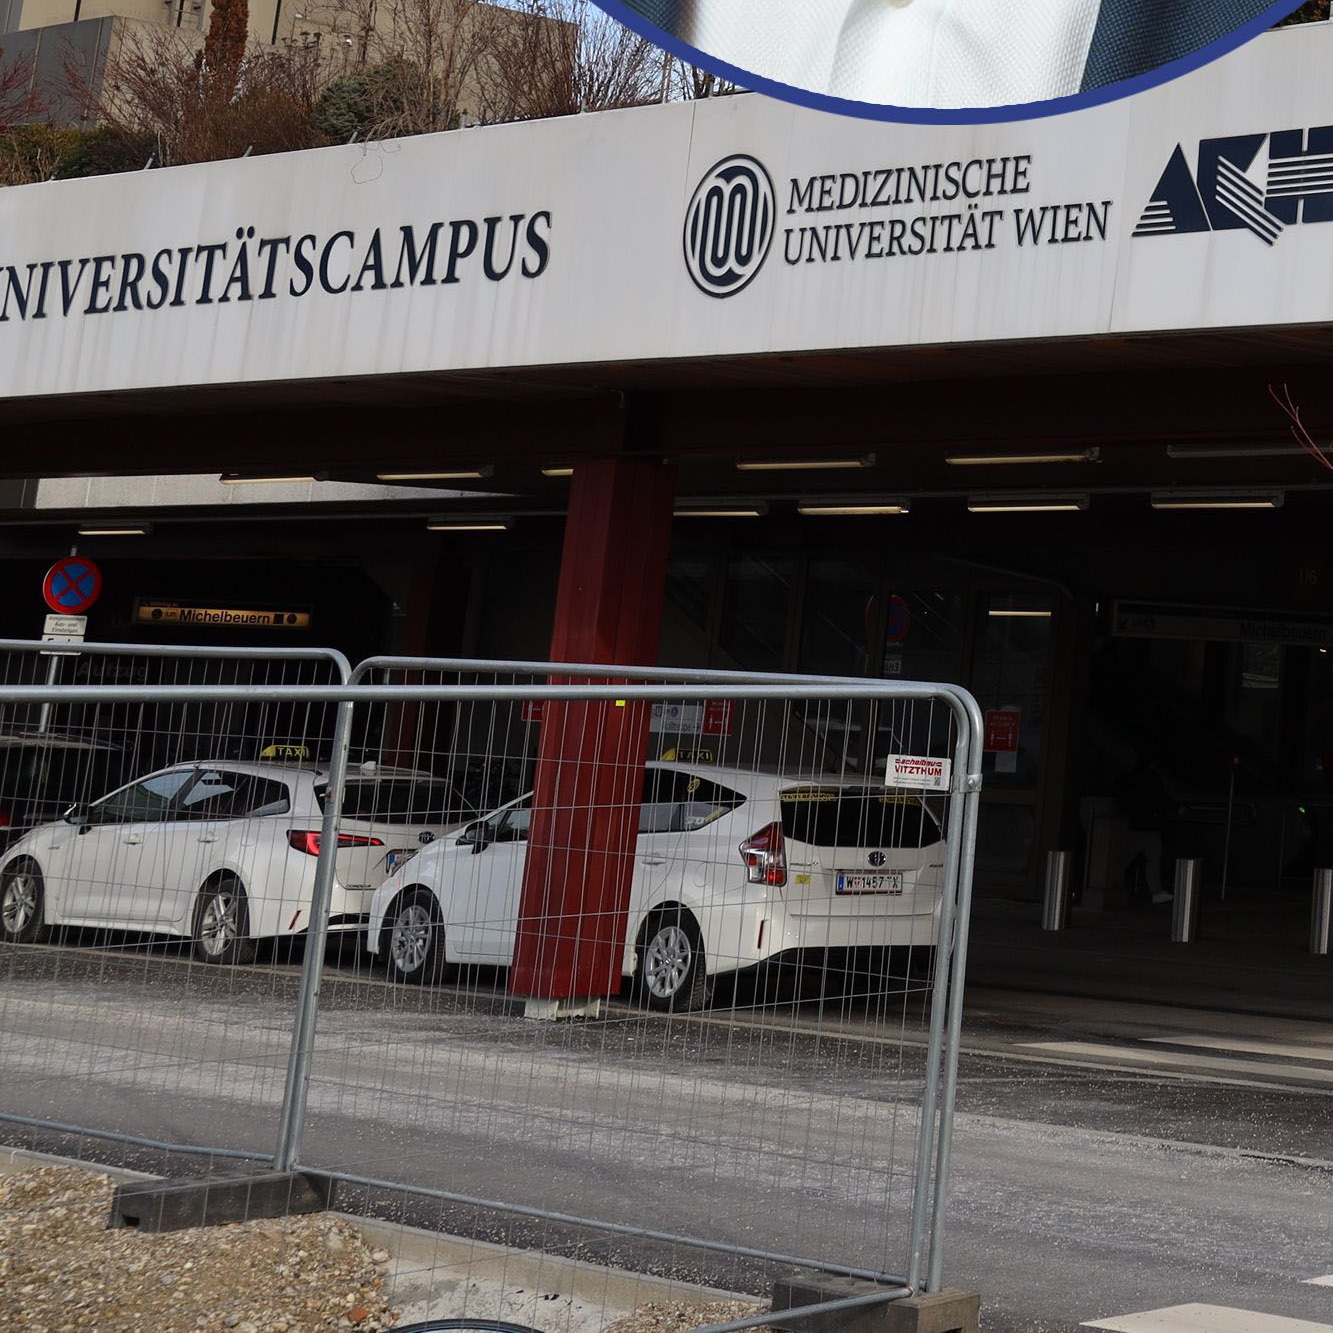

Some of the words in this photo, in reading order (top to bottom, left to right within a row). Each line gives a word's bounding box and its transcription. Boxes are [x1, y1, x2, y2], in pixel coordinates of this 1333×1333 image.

[785, 154, 1032, 215] MEDIZINISCHE
[783, 202, 1002, 266] UNIVERSITÄT
[1013, 200, 1114, 248] WIEN
[0, 210, 553, 322] NIVERSITÄTSCAMPUS
[180, 609, 271, 625] Michelbeuern
[277, 747, 306, 756] TAXI
[894, 765, 942, 776] VITZTHUM
